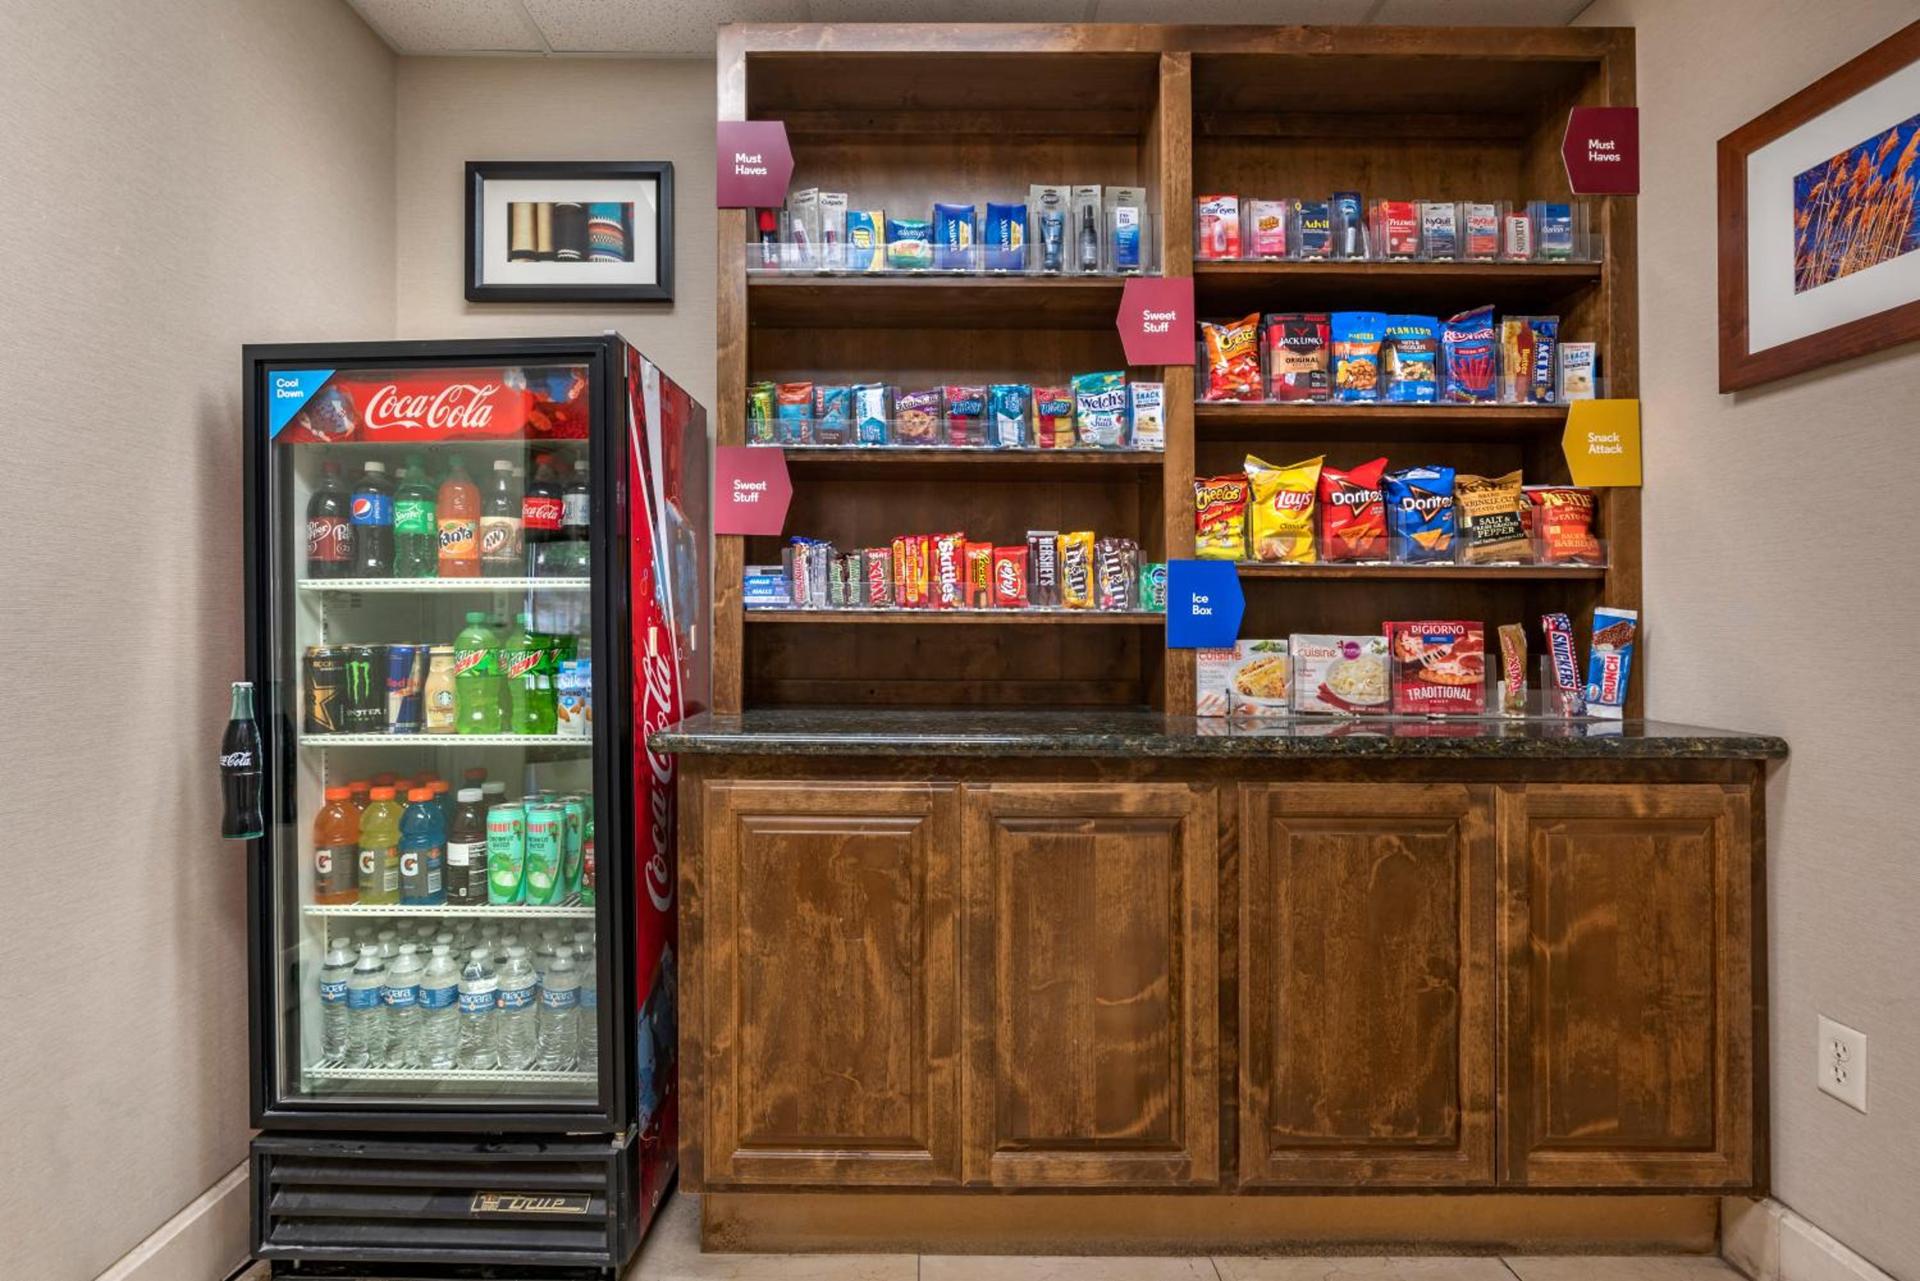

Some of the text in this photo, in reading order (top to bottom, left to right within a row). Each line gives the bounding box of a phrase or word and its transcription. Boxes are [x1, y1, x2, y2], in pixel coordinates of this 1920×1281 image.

[1588, 139, 1615, 149] Must
[735, 153, 762, 163] Must
[1588, 151, 1621, 161] Haves
[735, 164, 768, 175] Haves
[1304, 219, 1330, 228] Advil
[1143, 309, 1176, 321] Sweet
[1143, 322, 1169, 332] Stuff
[1285, 356, 1320, 364] ORIGINAL
[277, 379, 299, 388] Cool
[276, 389, 304, 398] Down
[1080, 391, 1125, 410] Welch's
[364, 384, 500, 429] Coca-Cola
[1587, 432, 1620, 442] Snack
[1588, 444, 1623, 455] Attack
[733, 479, 767, 490] Sweet
[733, 491, 759, 503] Stuff
[1196, 484, 1241, 511] Cheetos
[1331, 489, 1384, 505] Doritos
[1479, 517, 1503, 526] SALT
[1477, 526, 1515, 538] PEPPER
[938, 541, 956, 603] Skittles
[1192, 593, 1209, 603] Ice
[1192, 605, 1212, 615] Box
[1411, 625, 1464, 634] DIGIORNO
[1551, 632, 1573, 688] SNICKERS
[1602, 655, 1619, 703] CRUNCH
[1407, 687, 1473, 701] TRADITIONAL
[316, 850, 332, 873] G
[359, 850, 375, 874] G
[400, 853, 419, 876] G
